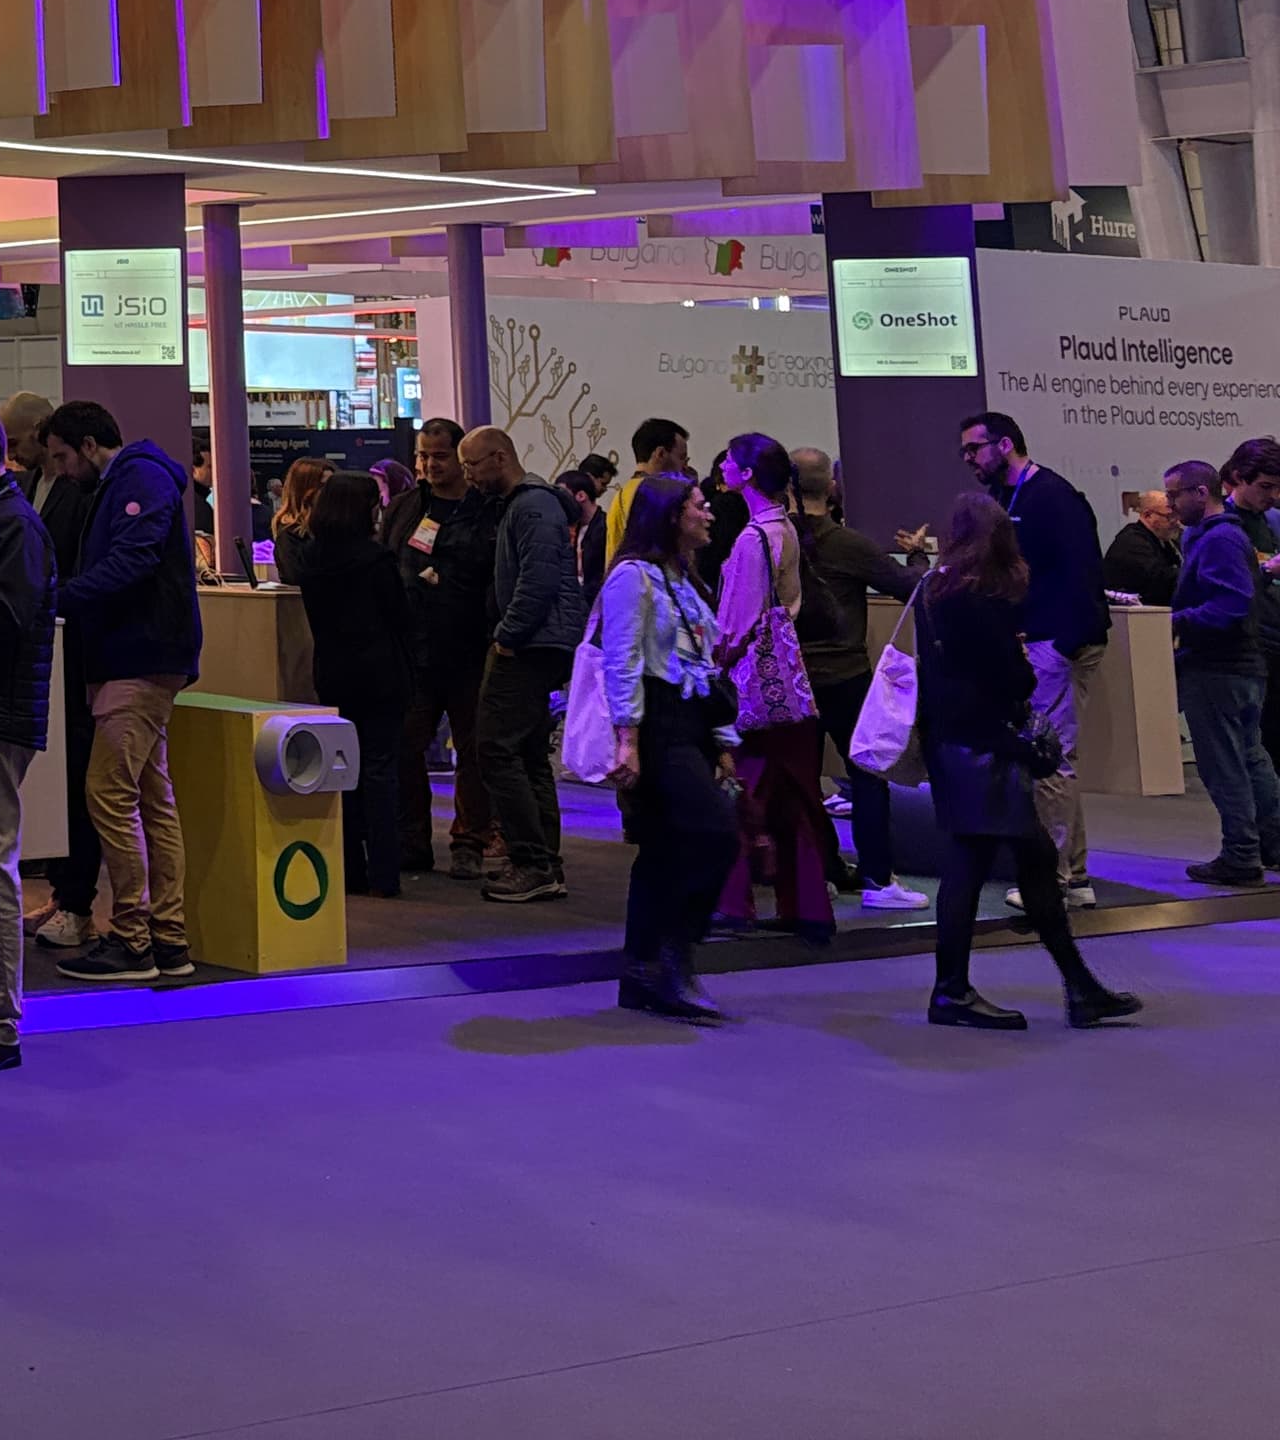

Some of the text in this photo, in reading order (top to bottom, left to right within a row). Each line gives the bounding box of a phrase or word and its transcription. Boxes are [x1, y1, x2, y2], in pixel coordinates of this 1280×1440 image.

[1090, 215, 1137, 240] Hurre
[880, 311, 959, 328] OneShot
[1118, 306, 1171, 323] PLAUD
[1059, 334, 1234, 370] Plaud Intelligence
[999, 371, 1028, 393] The
[1033, 373, 1047, 392] AI
[1052, 375, 1106, 397] engine
[1109, 375, 1165, 396] behind
[1168, 383, 1208, 401] every
[1063, 404, 1244, 431] in the Plaud ecosystem.
